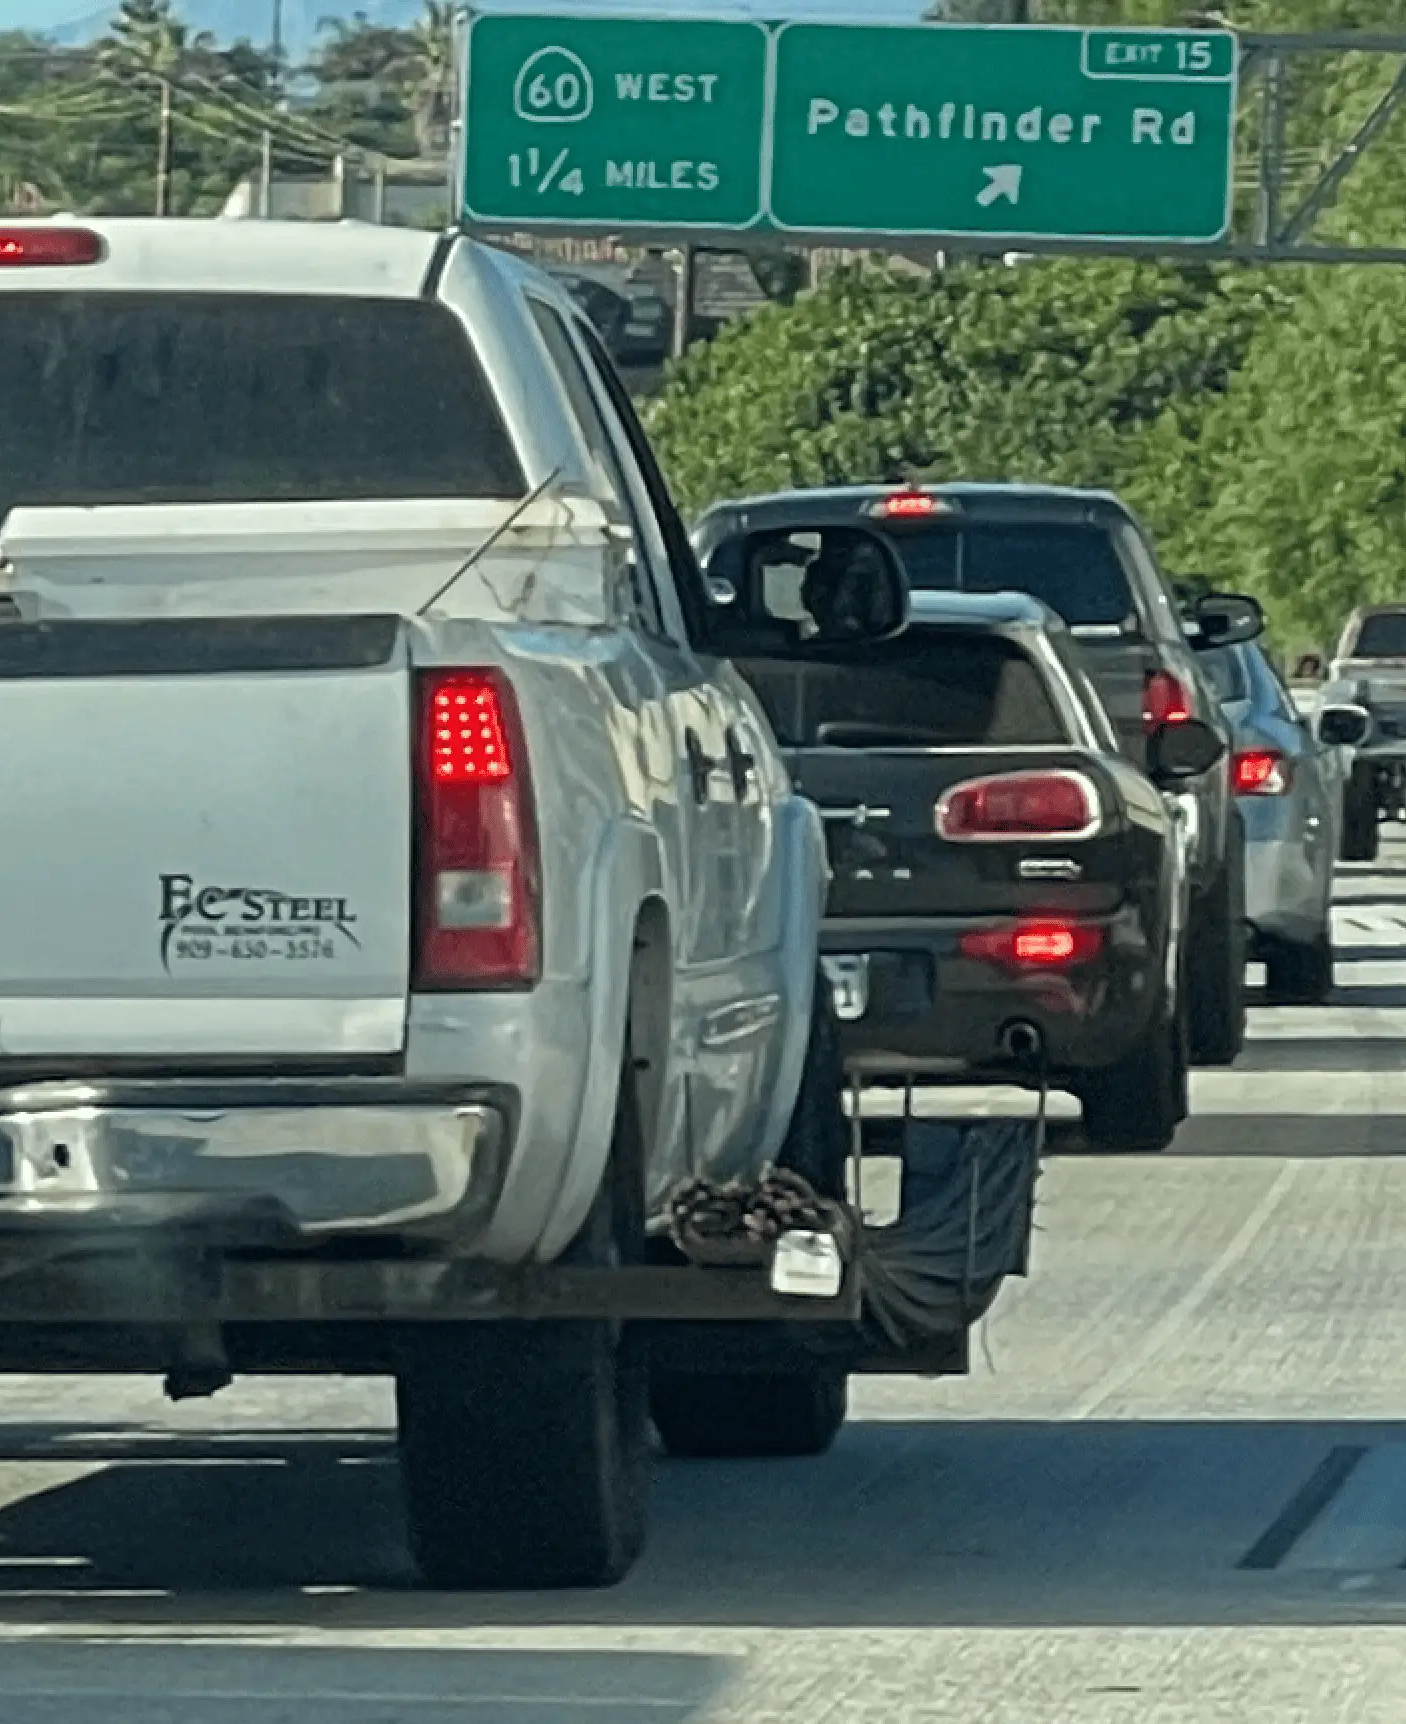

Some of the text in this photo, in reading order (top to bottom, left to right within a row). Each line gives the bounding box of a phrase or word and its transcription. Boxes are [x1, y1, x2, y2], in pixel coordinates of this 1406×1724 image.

[1105, 41, 1212, 70] EXIT 15
[528, 73, 719, 109] 60 WEST
[807, 98, 1196, 146] Pathfinder Rd
[605, 160, 720, 191] MILES
[240, 893, 358, 922] STEEL
